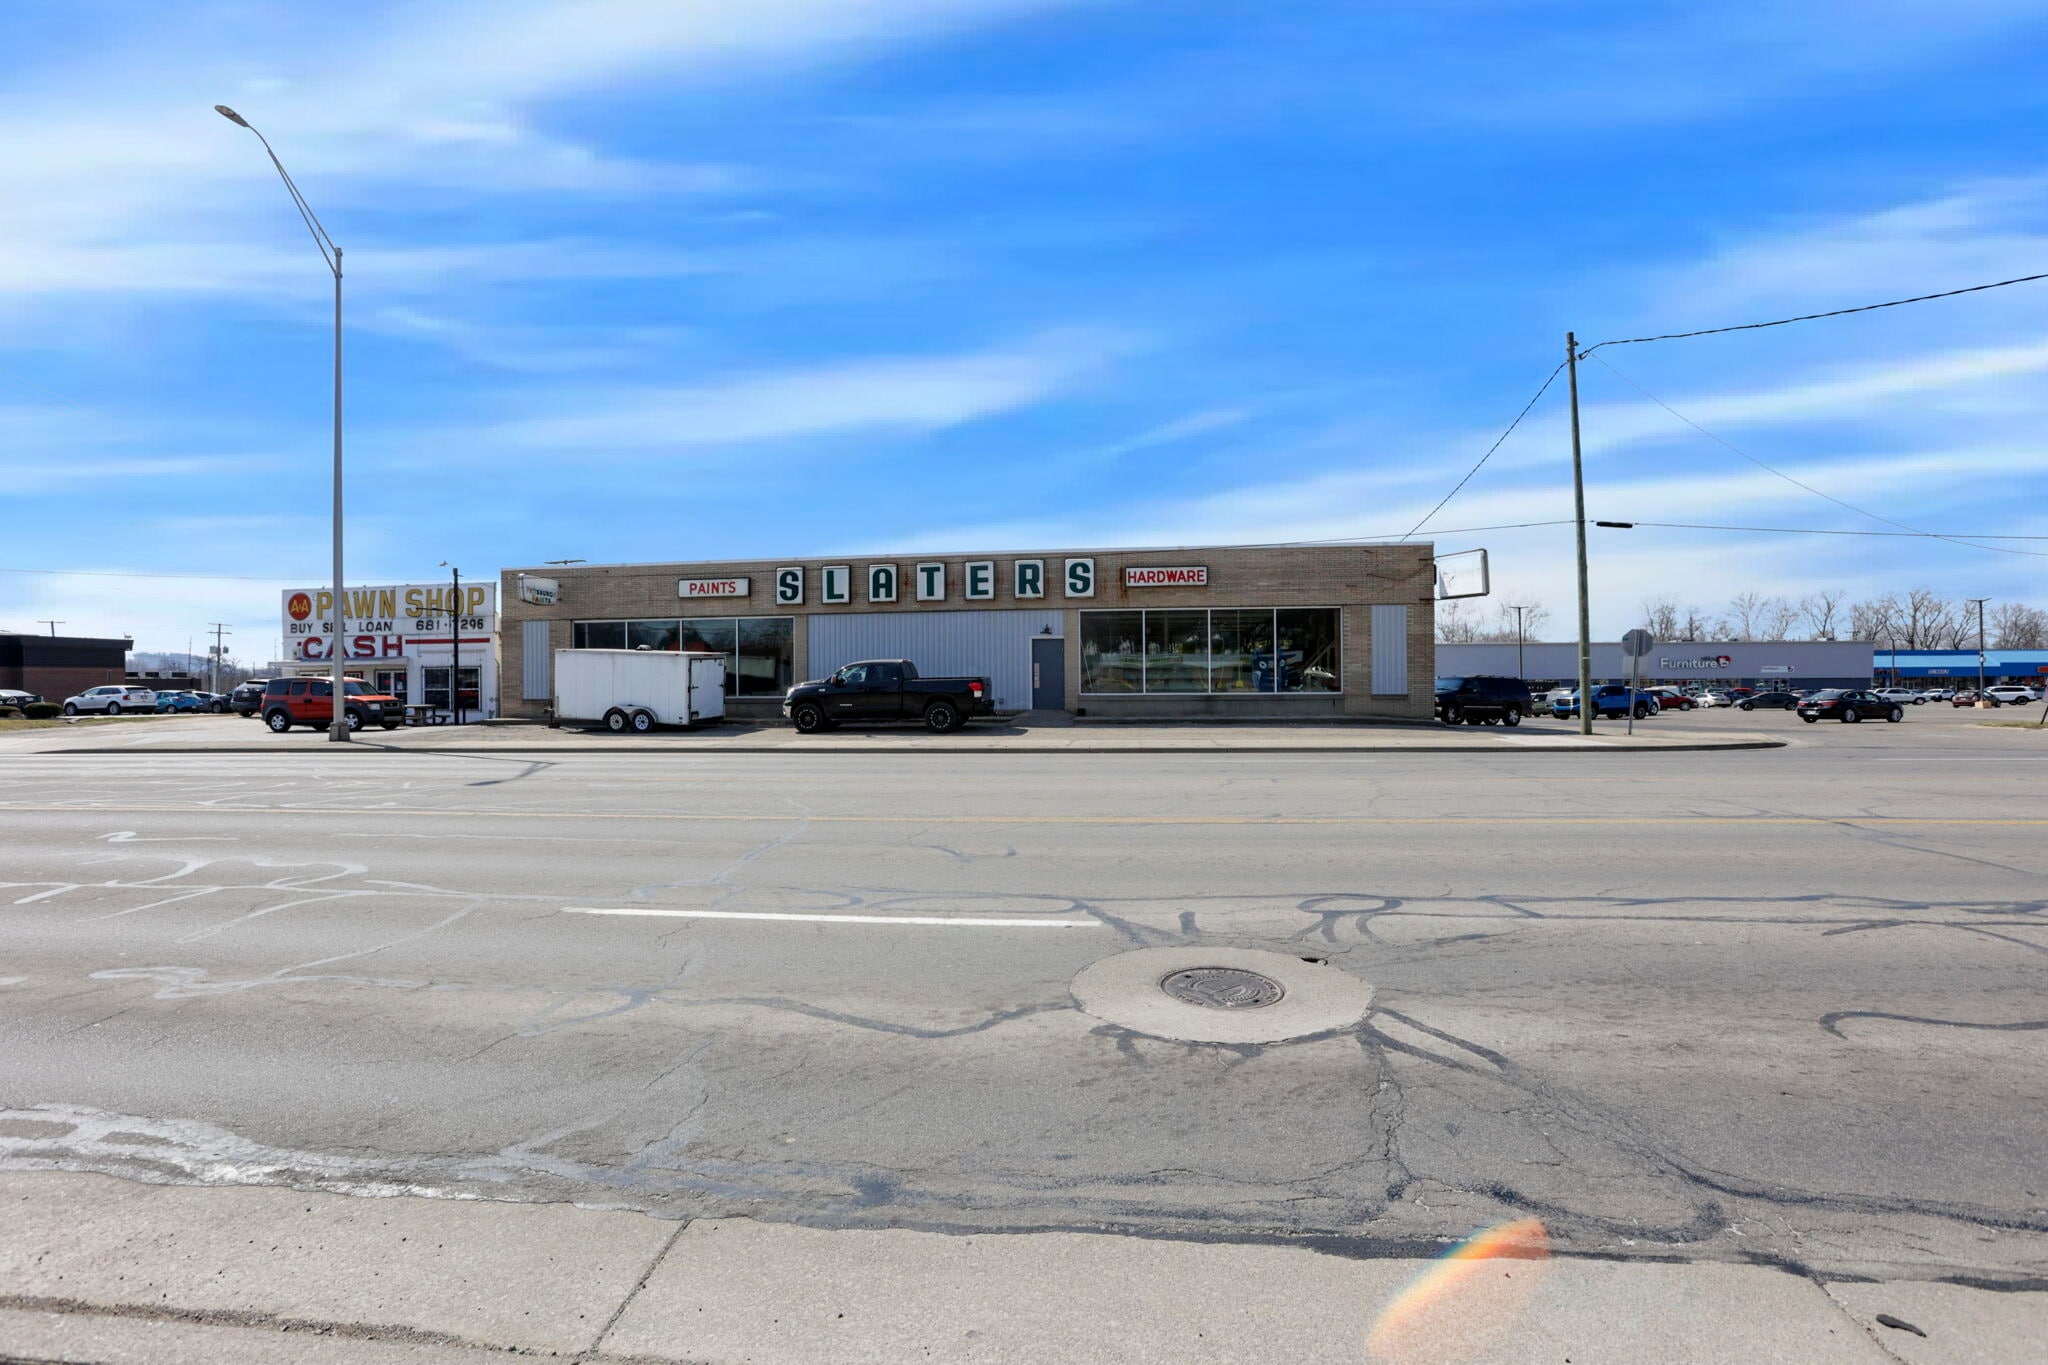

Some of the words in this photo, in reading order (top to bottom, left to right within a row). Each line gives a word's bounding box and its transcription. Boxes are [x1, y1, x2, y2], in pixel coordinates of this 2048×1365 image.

[779, 562, 1091, 601] SLATERS
[1127, 569, 1206, 584] HARDWARE
[689, 581, 736, 595] PAINTS
[405, 587, 485, 618] SHOP
[290, 623, 313, 633] BUY
[322, 622, 348, 633] SL
[358, 621, 393, 632] LOAN
[302, 635, 403, 659] CASH
[1660, 657, 1718, 669] Furniture
